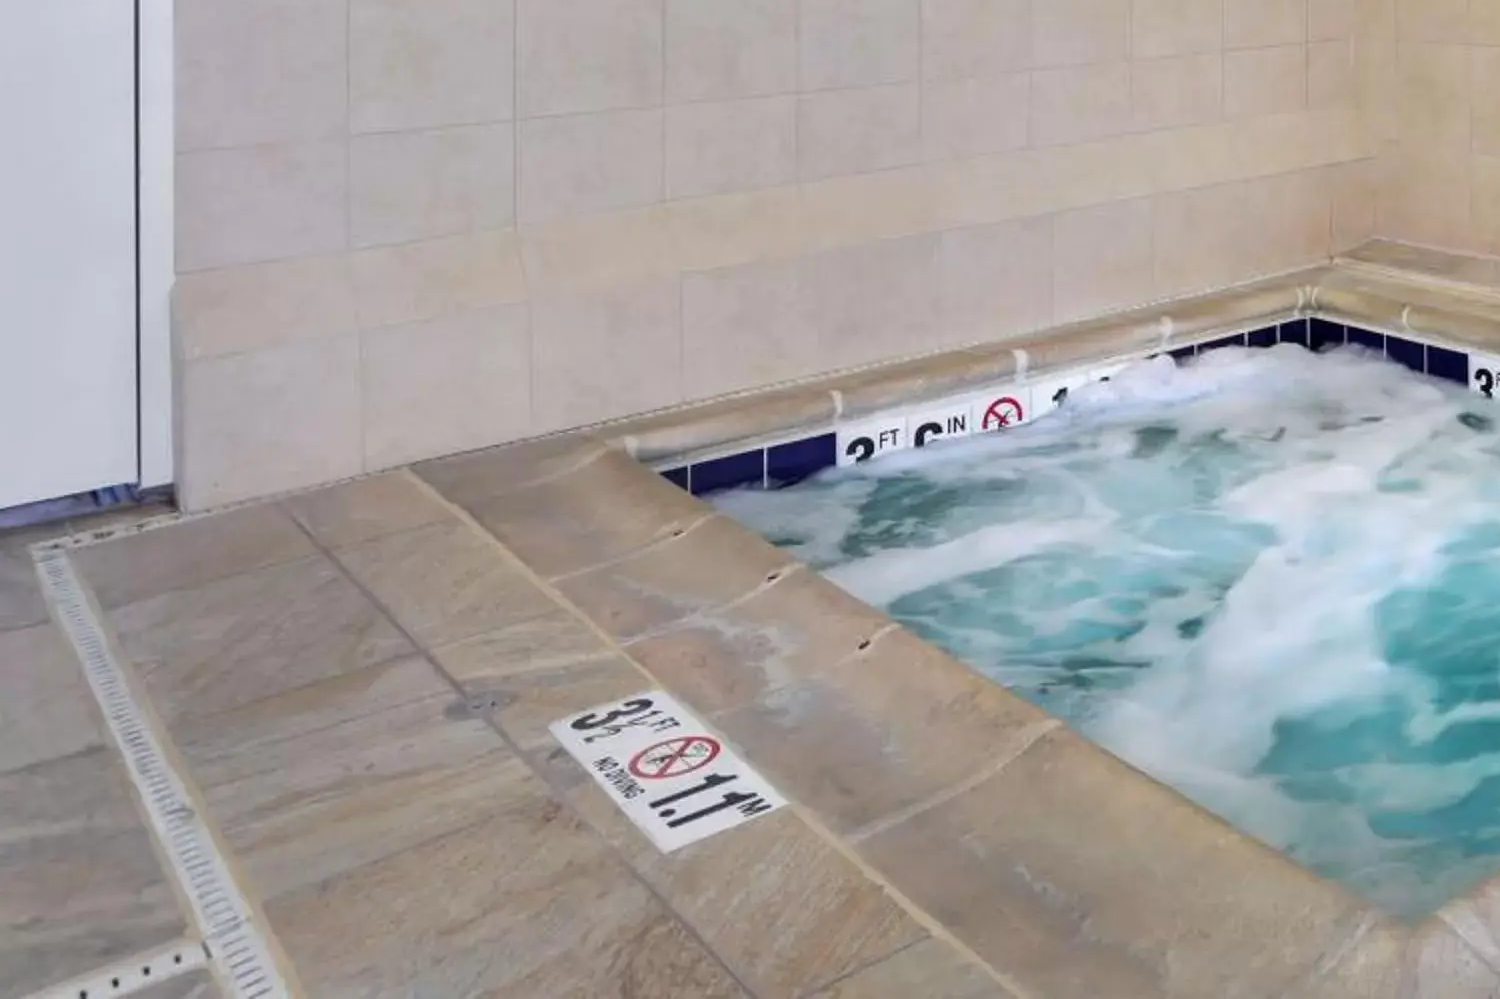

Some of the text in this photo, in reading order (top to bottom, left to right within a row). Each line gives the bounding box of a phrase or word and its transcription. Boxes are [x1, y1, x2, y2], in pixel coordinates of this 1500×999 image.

[879, 429, 900, 449] FT
[947, 415, 965, 433] IN
[592, 756, 645, 799] NO DIVING
